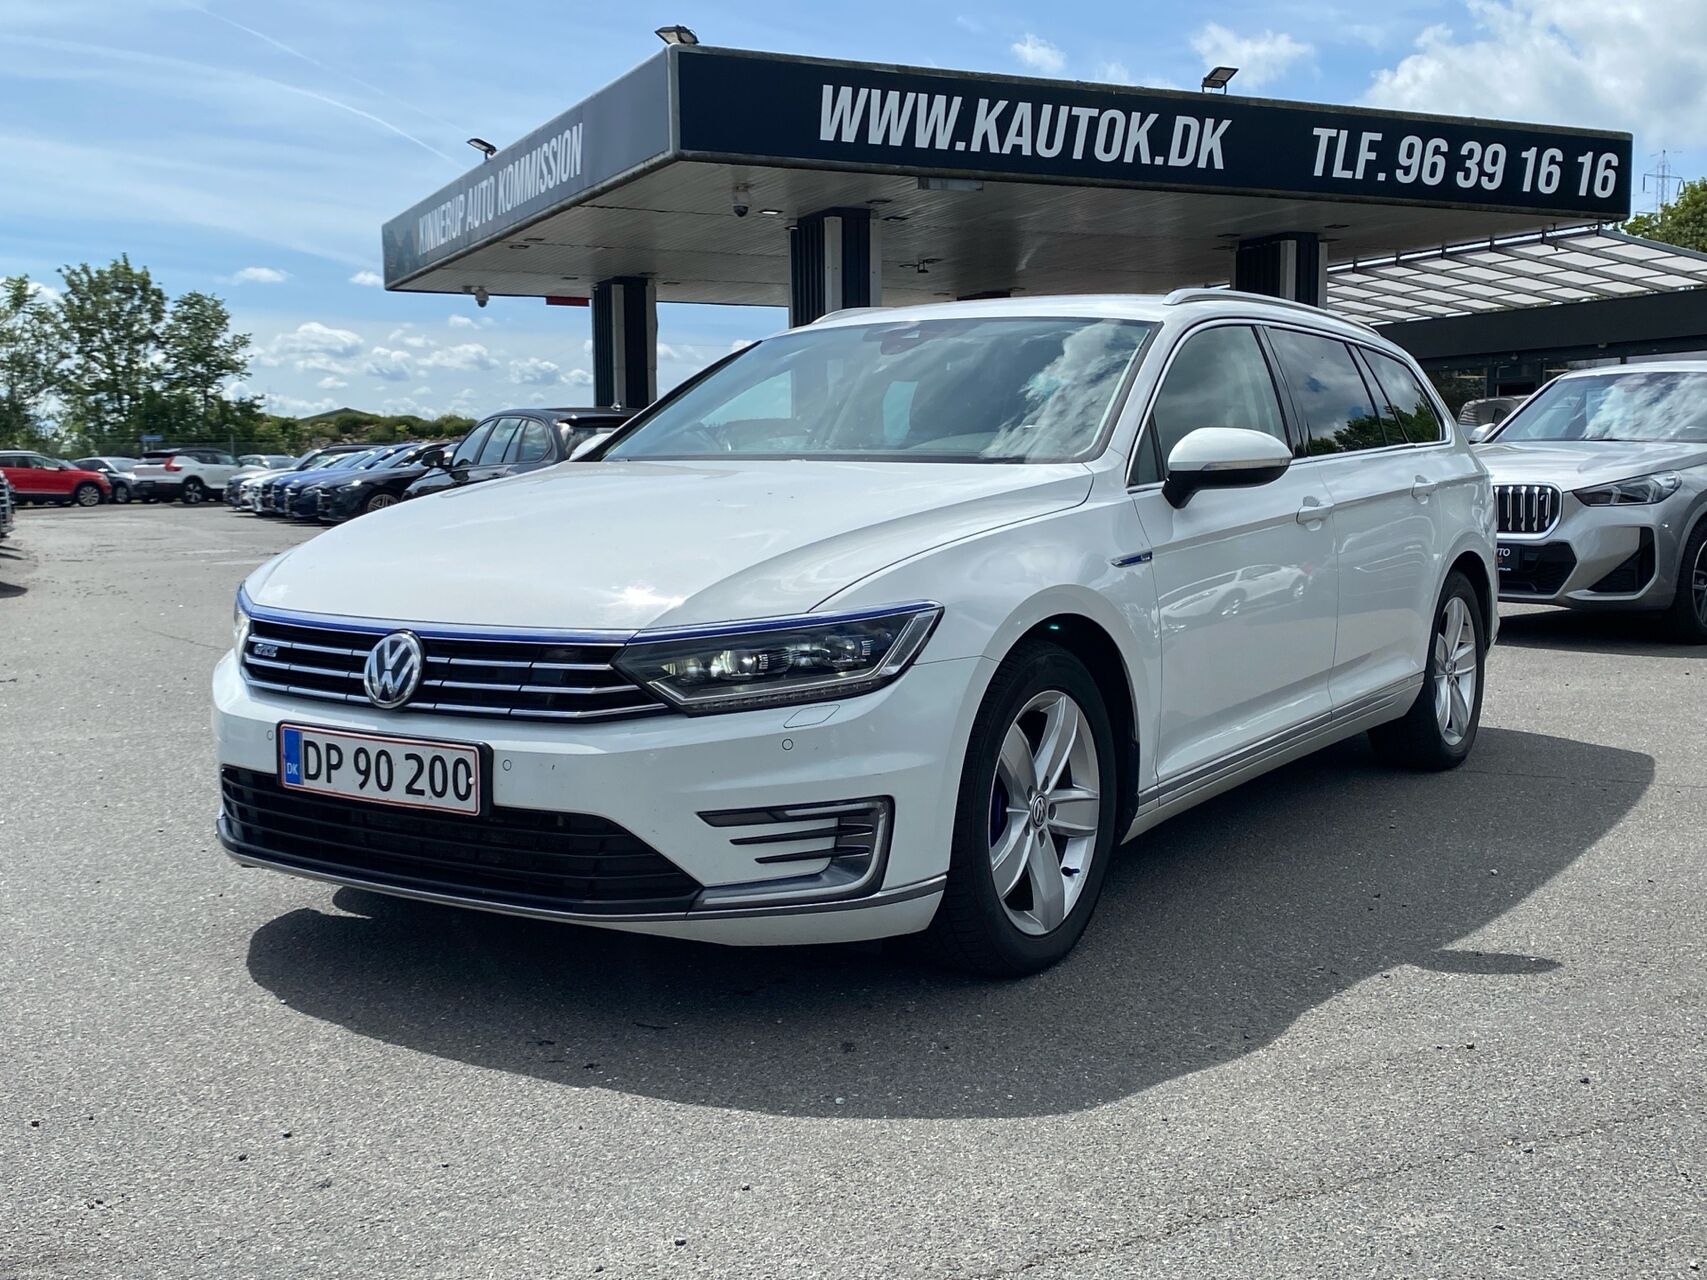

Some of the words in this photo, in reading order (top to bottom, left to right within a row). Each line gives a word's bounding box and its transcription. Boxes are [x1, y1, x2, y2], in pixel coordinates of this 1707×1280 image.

[819, 84, 1232, 170] WWW.KAUTOK.DK
[1312, 127, 1387, 181] TLF.
[1395, 135, 1448, 186] 96
[1456, 140, 1507, 190] 39
[1521, 146, 1563, 194] 16
[1577, 151, 1619, 198] 16
[466, 175, 495, 232] AUTO
[497, 122, 583, 216] KOMMISSION
[286, 762, 299, 775] DK
[303, 739, 343, 783] DP
[353, 746, 394, 792] 90
[404, 753, 472, 801] 200
